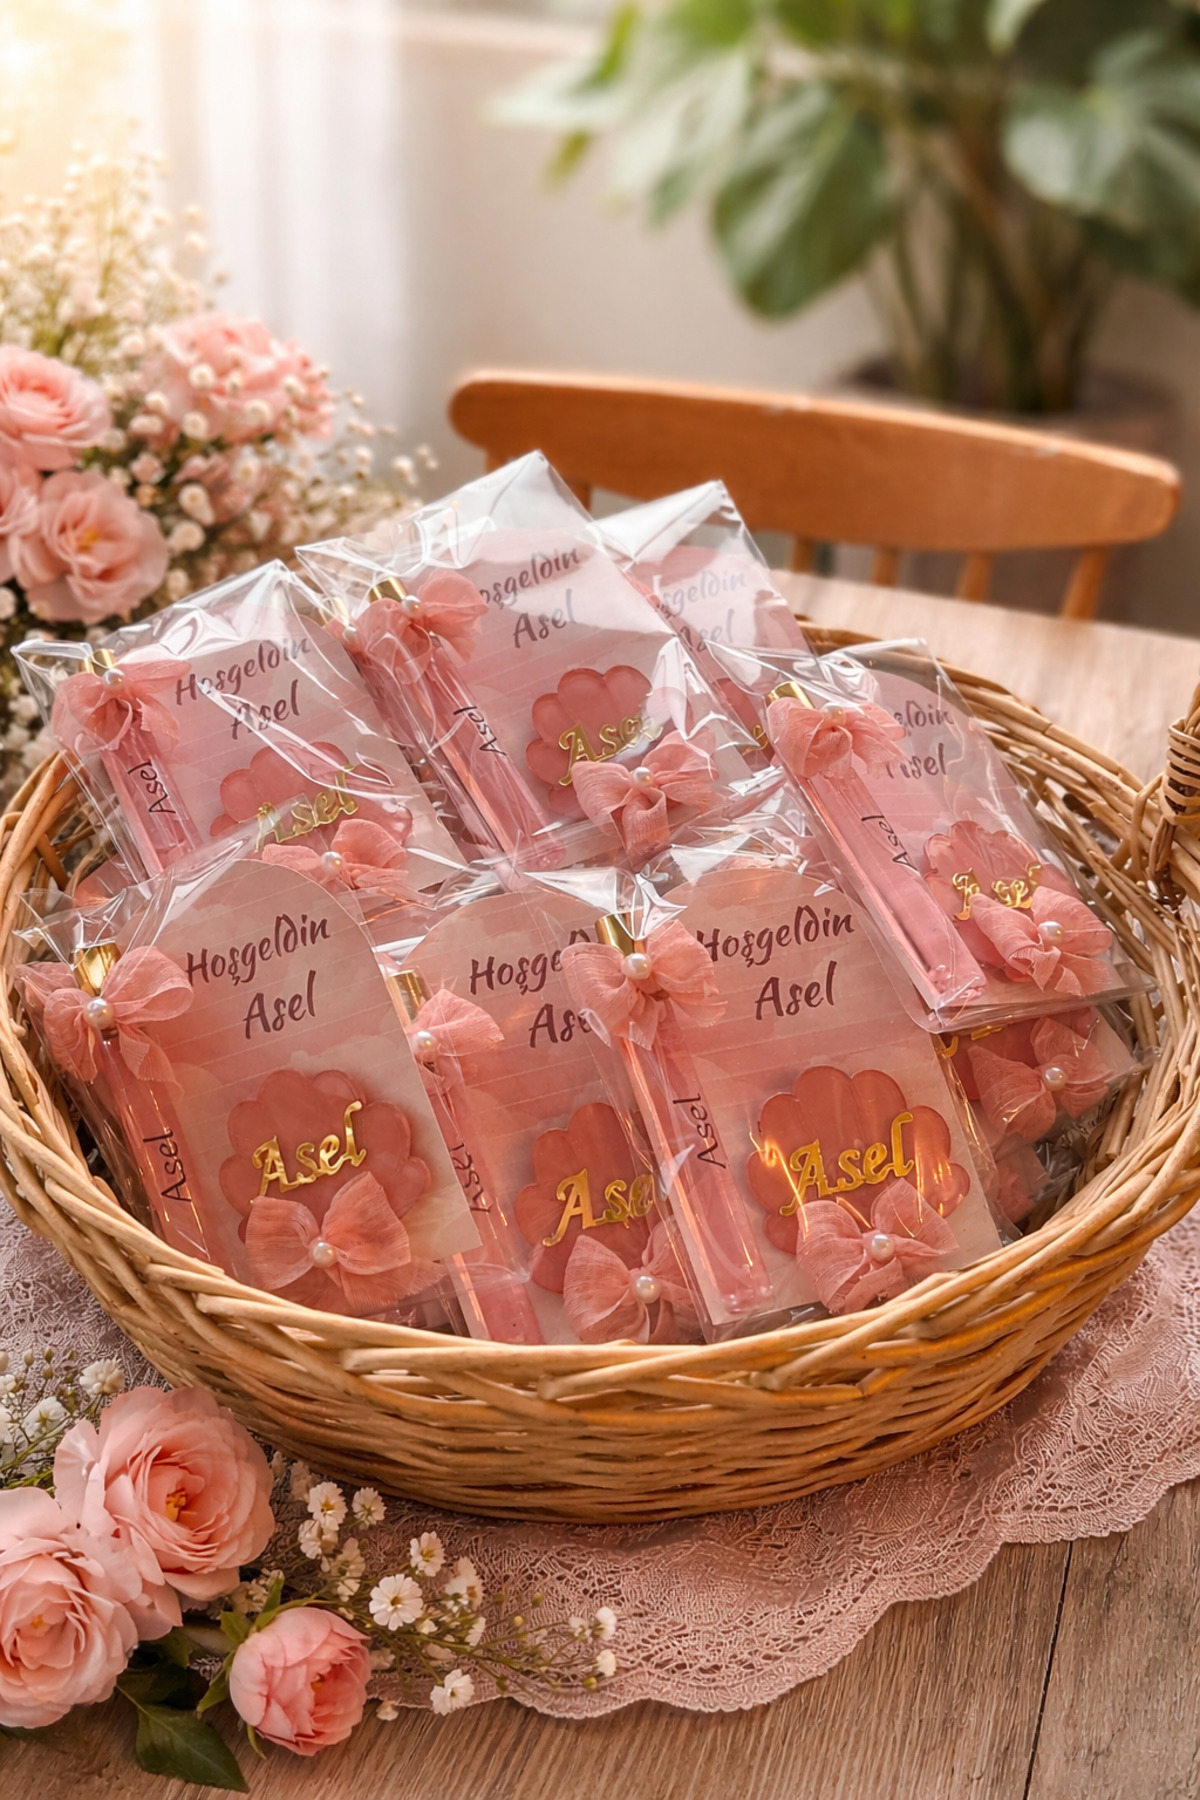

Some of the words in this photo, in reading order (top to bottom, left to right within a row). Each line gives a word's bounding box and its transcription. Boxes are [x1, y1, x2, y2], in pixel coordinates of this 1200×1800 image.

[479, 548, 580, 609] oşgeldin
[513, 587, 576, 649] Asel
[453, 706, 507, 756] Asel
[127, 759, 176, 815] Asel
[253, 763, 359, 853] Asel
[185, 913, 331, 986] Hoşgeldin
[470, 929, 592, 996] Hoşge
[696, 904, 855, 968] Hoşgeldin
[242, 969, 317, 1040] Asel
[755, 960, 837, 1020] Asel
[528, 1003, 593, 1048] Ase
[143, 1127, 192, 1202] Asel
[250, 1100, 367, 1205] Asel
[672, 1092, 727, 1169] Asel
[780, 1112, 914, 1218] Asel
[542, 1167, 655, 1247] Ase
